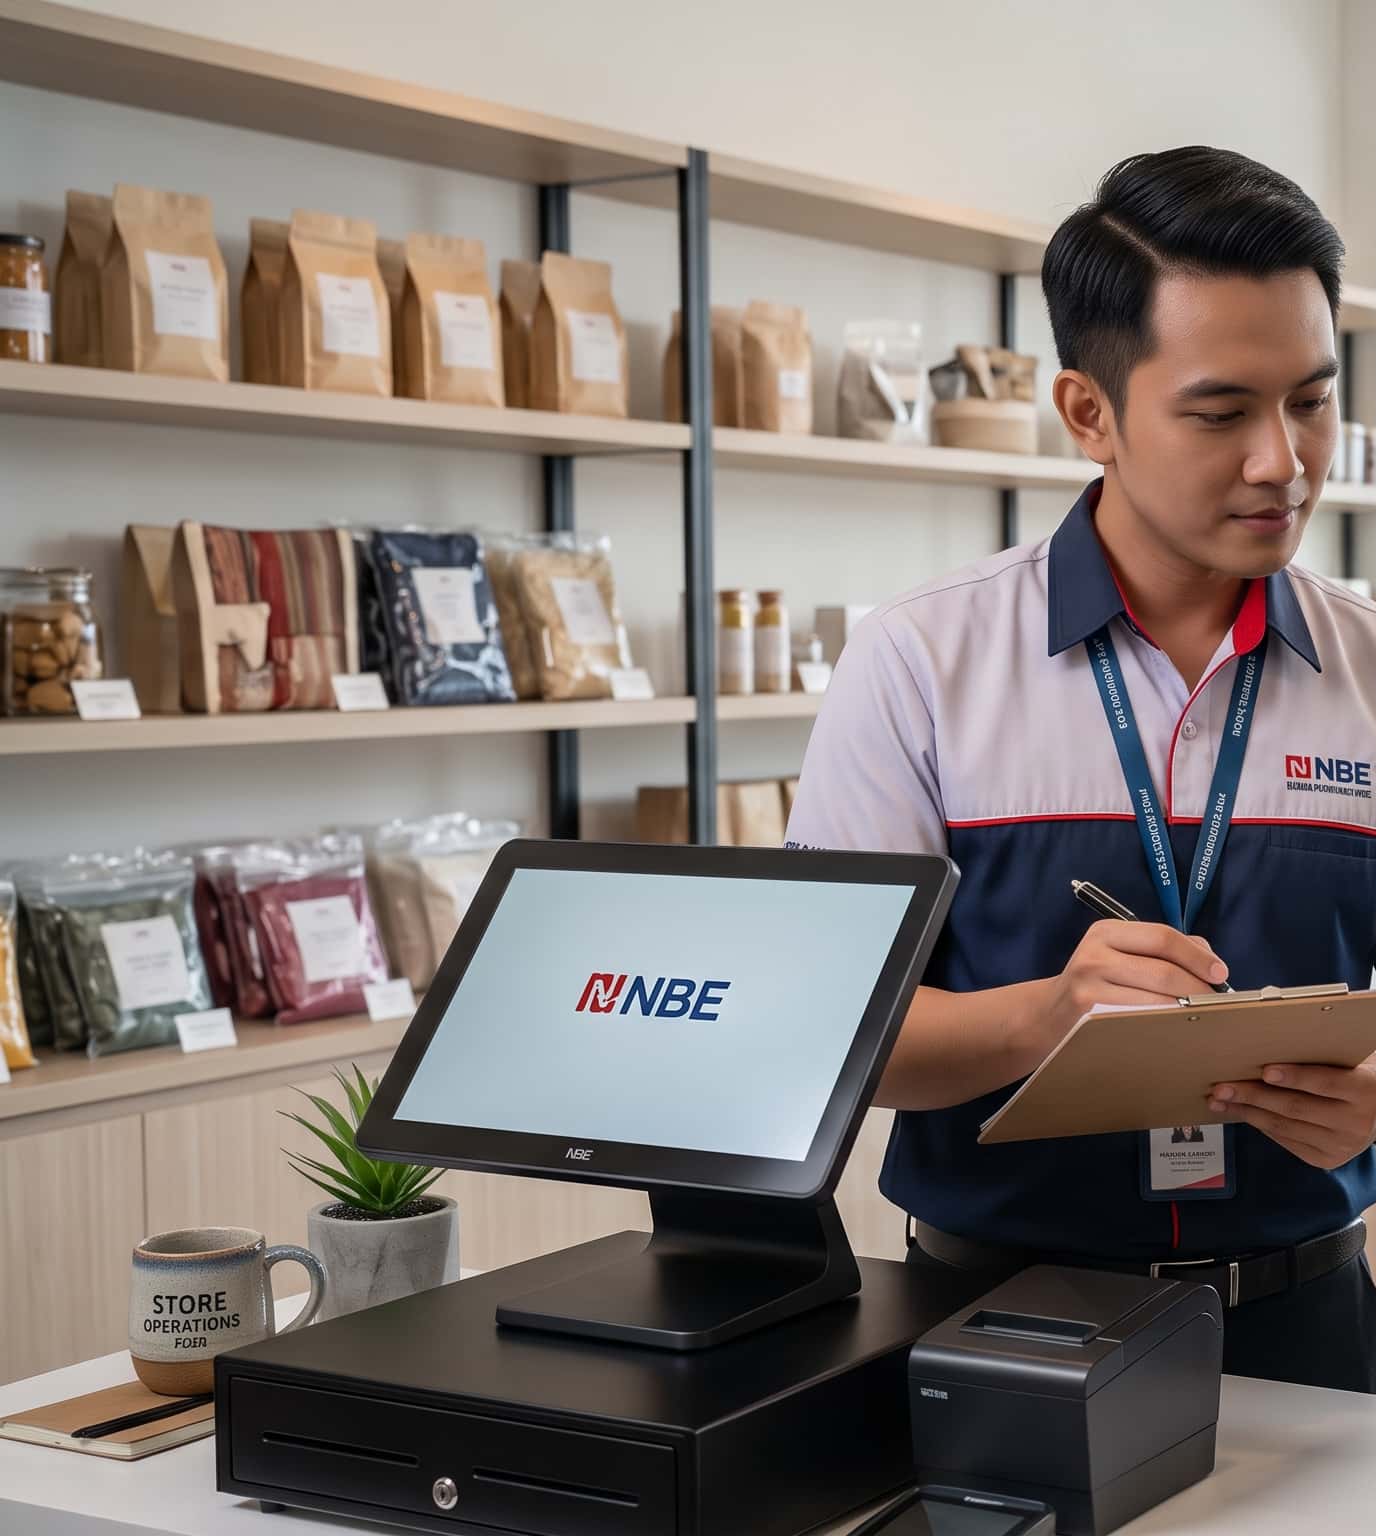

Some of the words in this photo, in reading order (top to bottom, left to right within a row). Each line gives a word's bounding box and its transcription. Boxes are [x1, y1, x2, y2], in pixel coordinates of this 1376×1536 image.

[1315, 757, 1371, 786] NBE
[619, 976, 732, 1021] NBE
[565, 1147, 594, 1160] NBE
[152, 1291, 227, 1315] STORE
[143, 1313, 240, 1334] OPERATIONS
